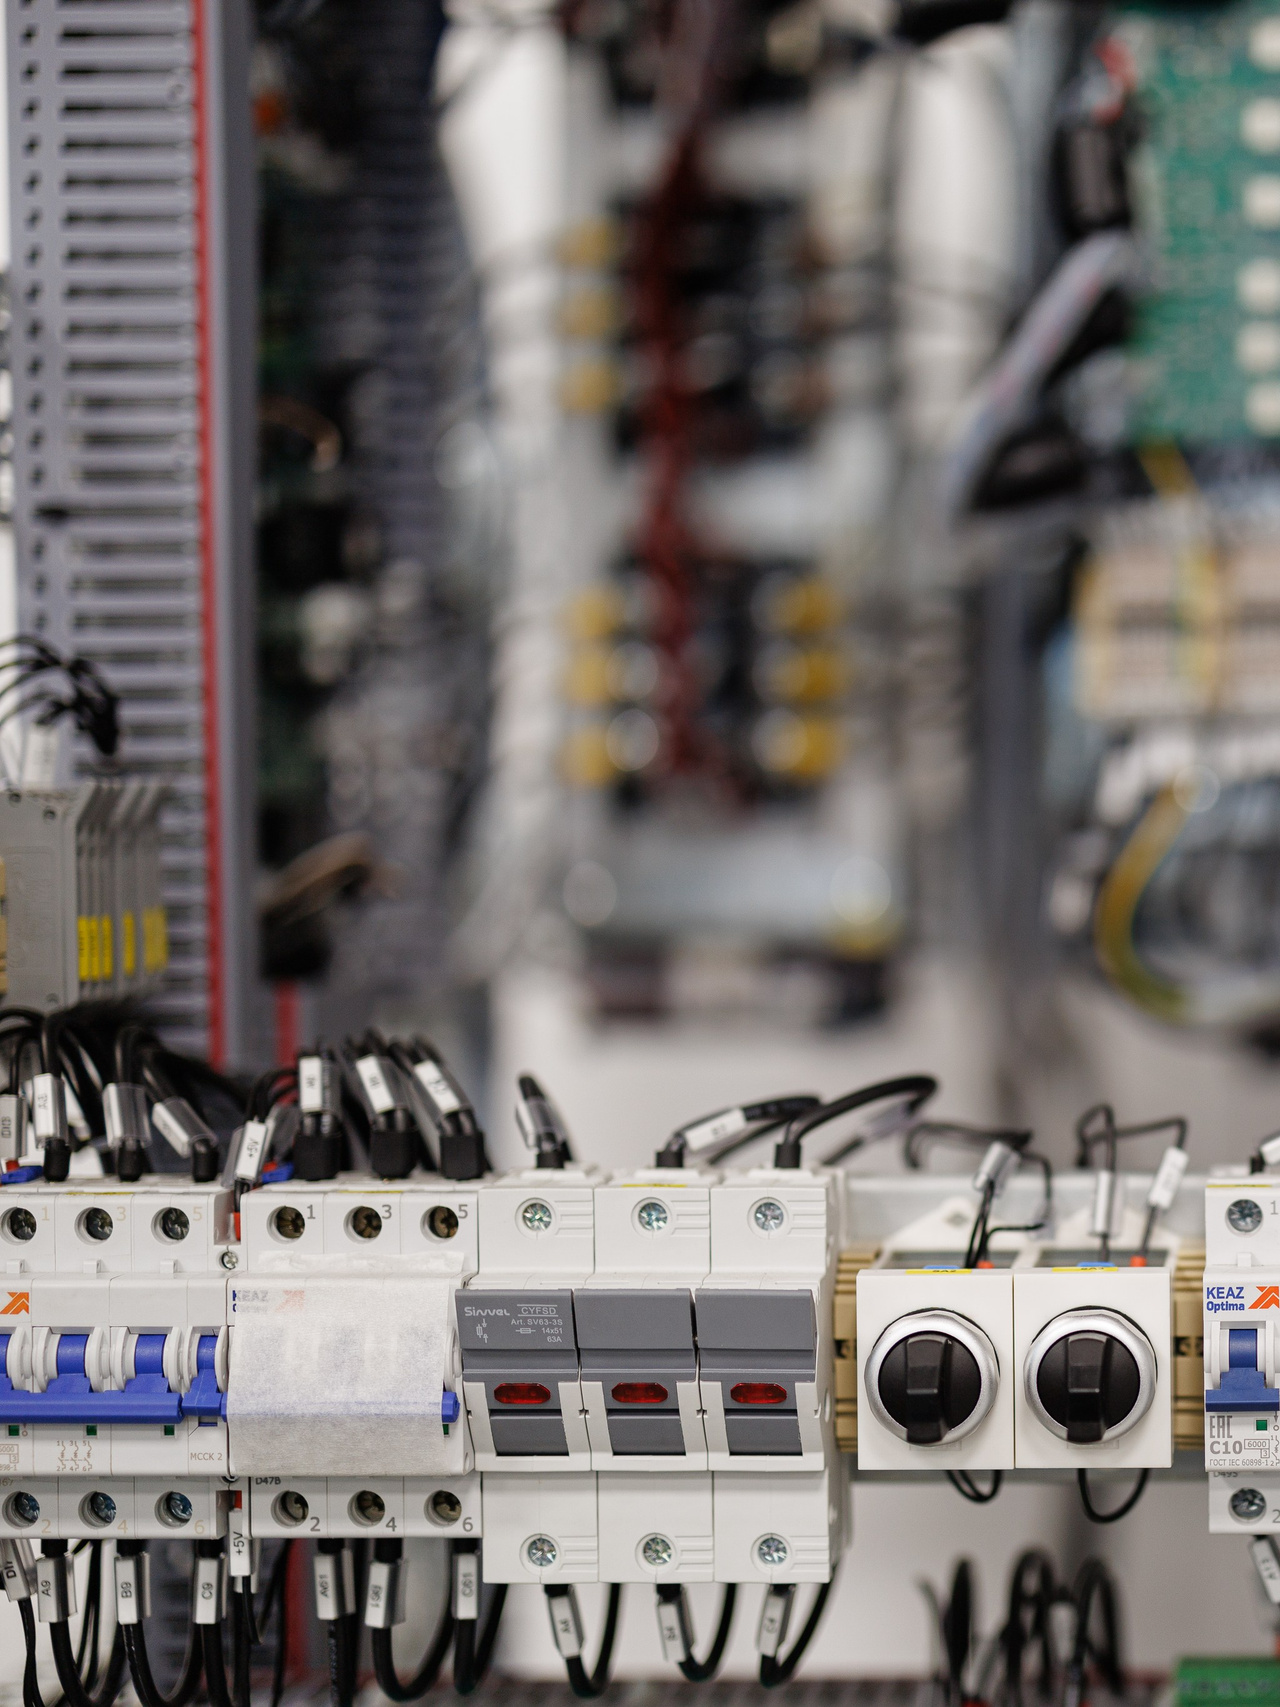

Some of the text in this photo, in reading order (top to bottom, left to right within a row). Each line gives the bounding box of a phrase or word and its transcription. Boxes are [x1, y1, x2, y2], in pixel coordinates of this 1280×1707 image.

[41, 1207, 50, 1221] 1
[116, 1206, 126, 1221] 3
[193, 1207, 202, 1221] 5
[307, 1204, 316, 1219] 1
[382, 1204, 392, 1219] 3
[458, 1204, 468, 1219] 5
[1270, 1201, 1279, 1215] 1
[1206, 1287, 1245, 1299] KEAZ
[521, 1307, 556, 1315] CYFSD
[1206, 1301, 1245, 1313] Optima
[1209, 1415, 1233, 1438] EAC
[1210, 1440, 1242, 1454] C10
[1247, 1440, 1266, 1448] 6000
[42, 1520, 52, 1534] 2
[117, 1519, 128, 1533] 4
[194, 1520, 205, 1534] 6
[310, 1517, 321, 1531] 2
[386, 1517, 397, 1531] 4
[463, 1517, 473, 1532] 6
[233, 1532, 244, 1556] +5V
[41, 1580, 51, 1597] A9
[121, 1582, 132, 1598] B9
[202, 1582, 213, 1599] C9
